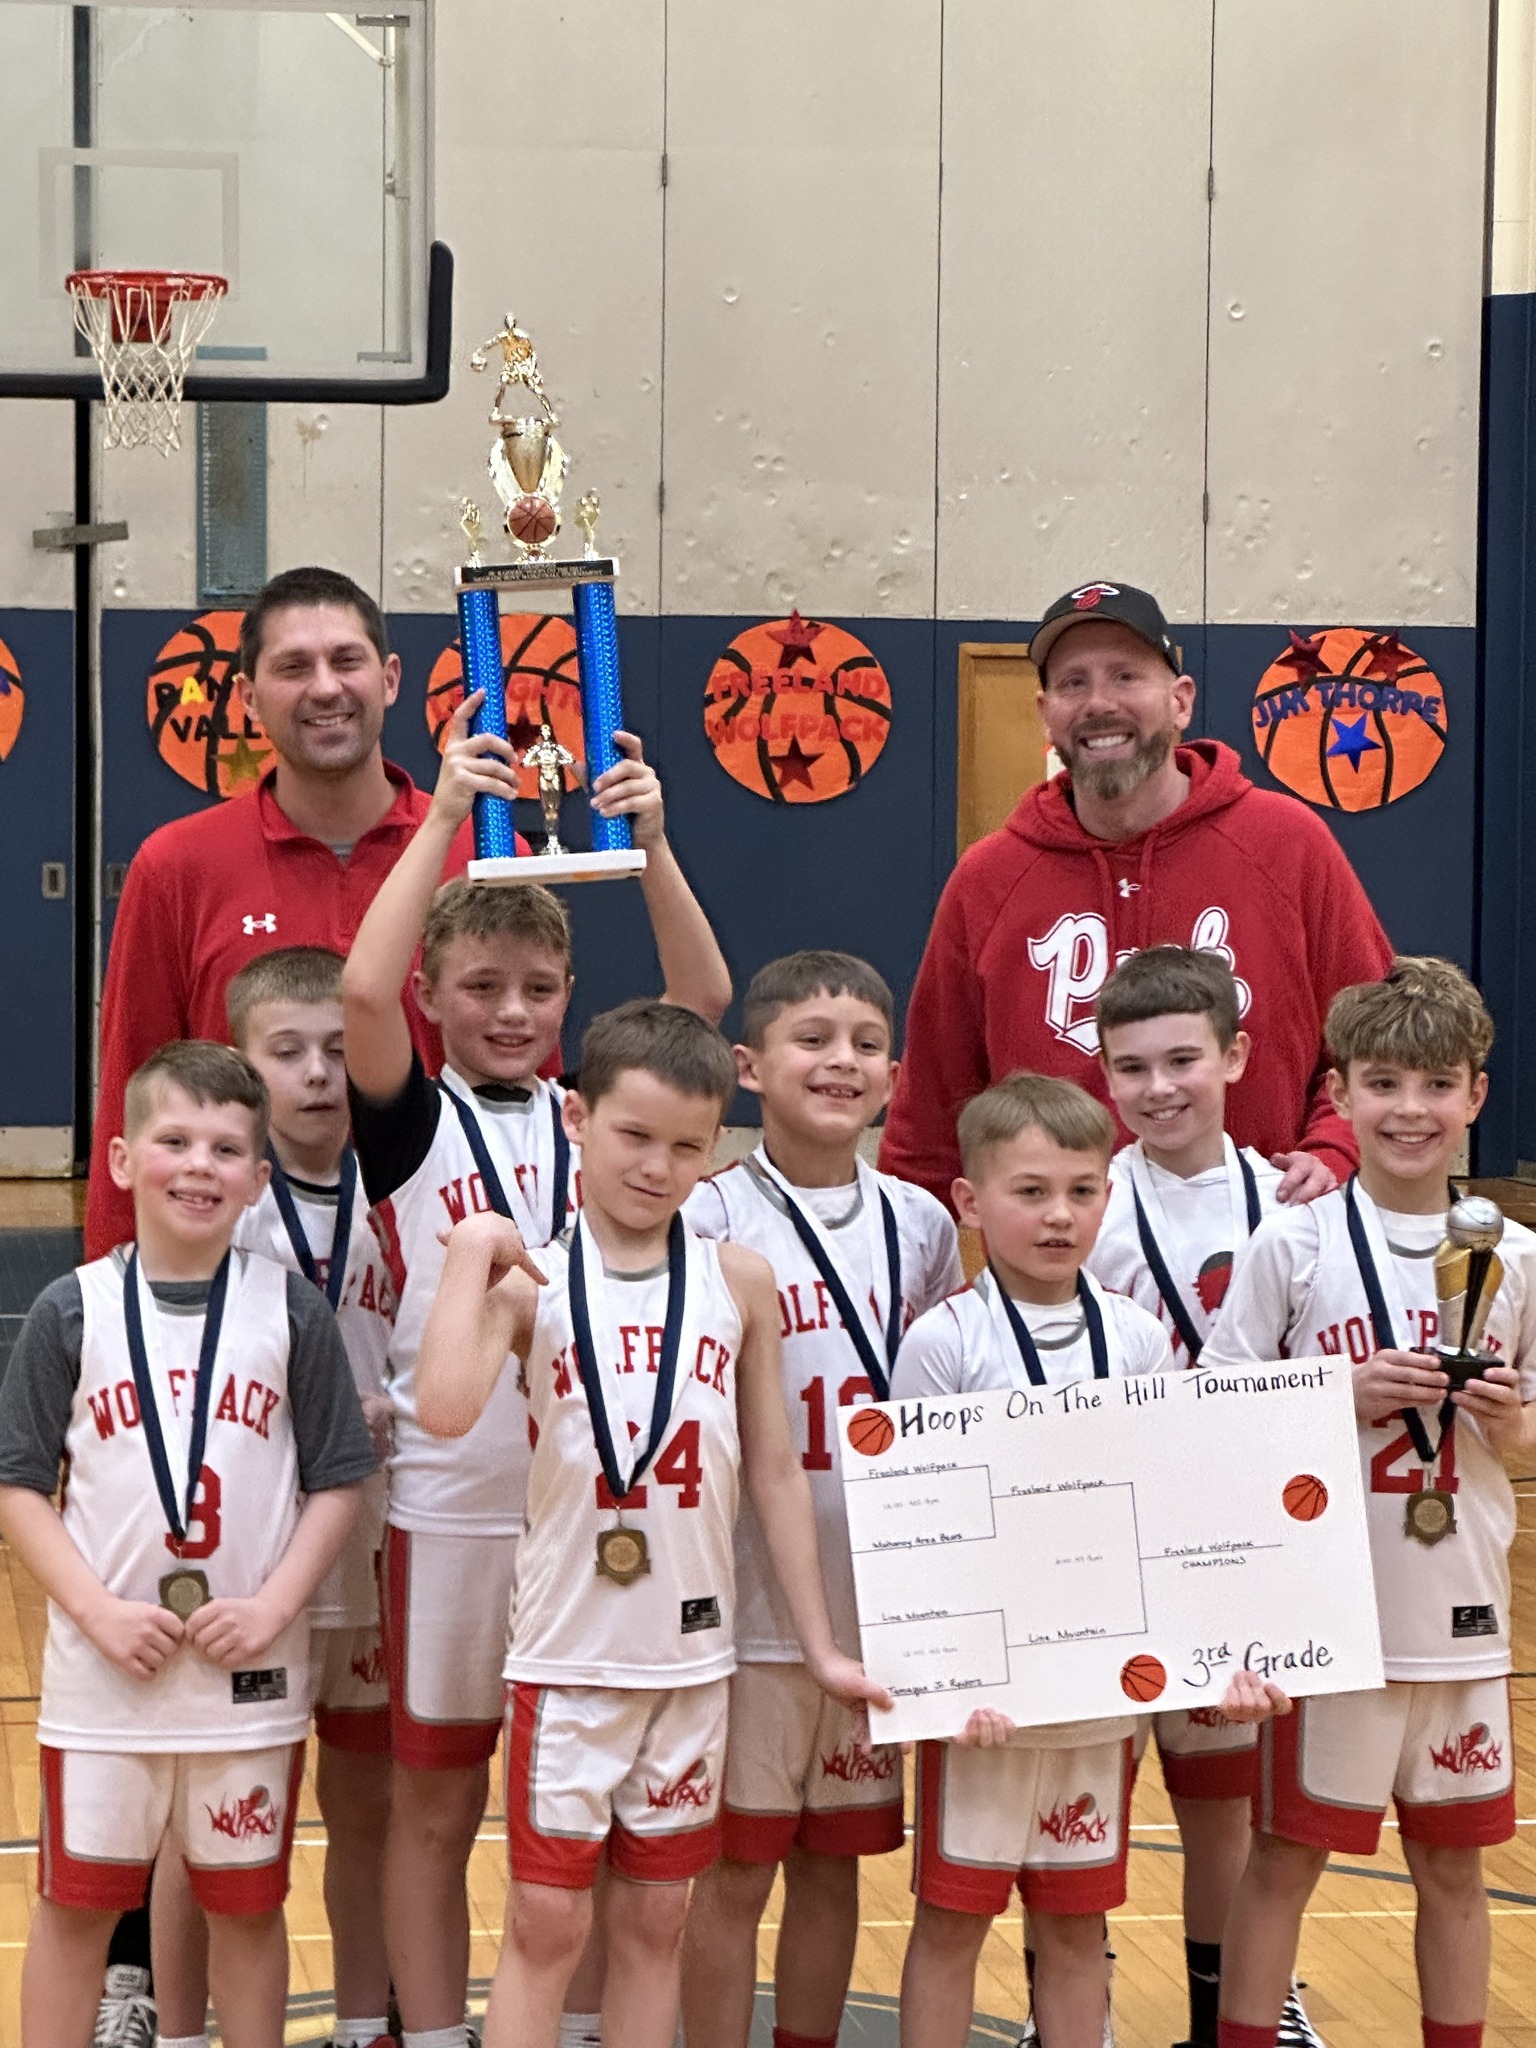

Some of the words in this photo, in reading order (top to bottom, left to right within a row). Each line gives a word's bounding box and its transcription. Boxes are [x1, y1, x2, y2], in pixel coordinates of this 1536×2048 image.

[711, 667, 886, 700] FREELAND
[1255, 687, 1311, 728] JIM
[1315, 681, 1442, 724] THORPE
[706, 713, 886, 746] WOLFPACK
[900, 1402, 984, 1438] Hoops
[1006, 1390, 1044, 1419] On
[1053, 1380, 1103, 1414] The
[1124, 1377, 1165, 1406] Hill
[1182, 1366, 1333, 1399] Tournament
[1181, 1555, 1248, 1570] CHAMPIONS
[1183, 1641, 1233, 1688] 3rd
[1243, 1639, 1334, 1679] Grade
